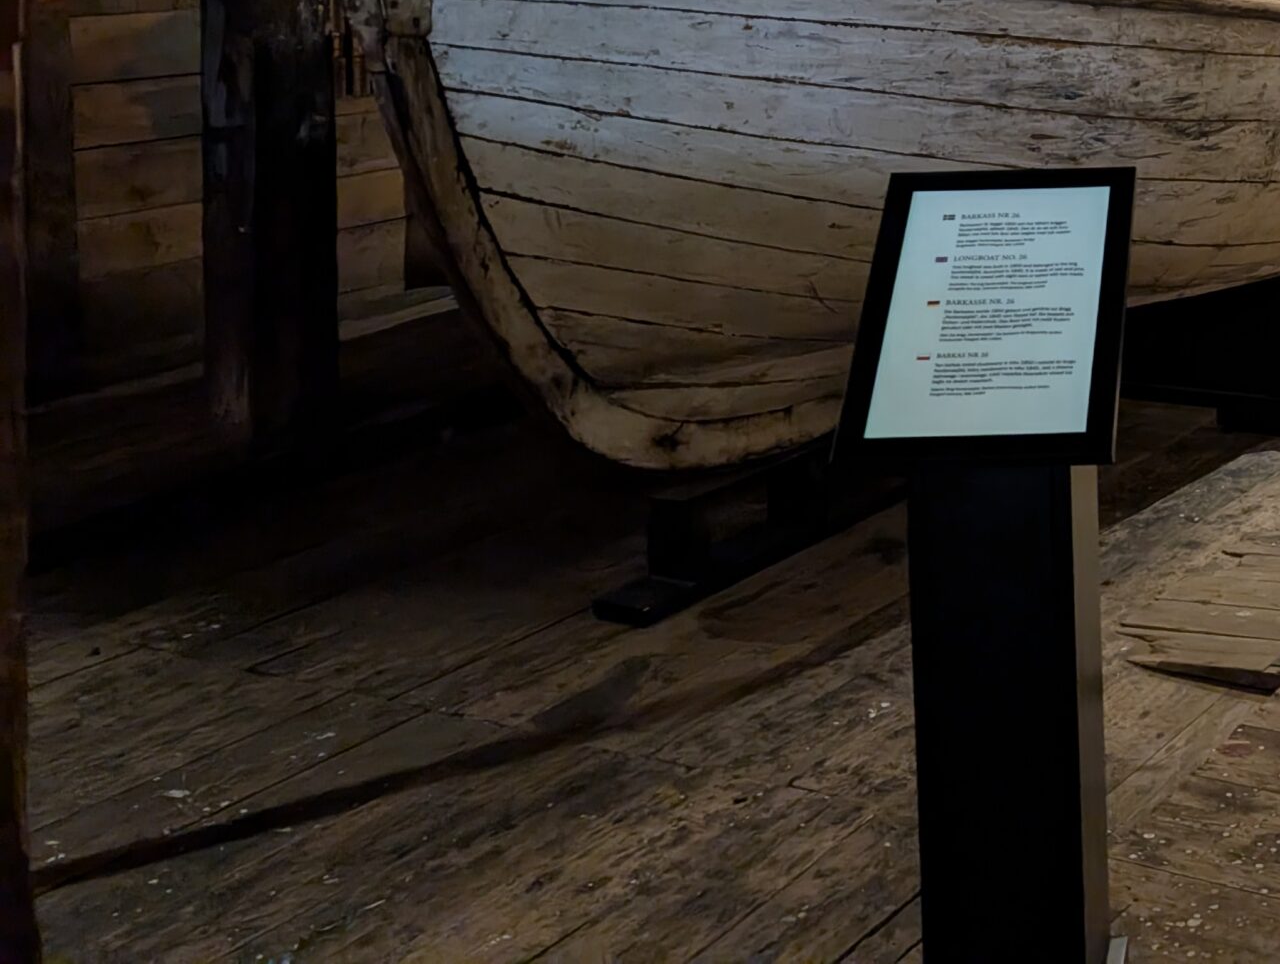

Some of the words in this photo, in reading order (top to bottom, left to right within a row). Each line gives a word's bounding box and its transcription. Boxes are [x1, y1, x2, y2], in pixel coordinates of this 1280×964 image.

[961, 212, 996, 220] BARKASS
[953, 254, 1000, 262] LONGBOAT
[945, 298, 987, 306] BARKASSE
[1006, 297, 1015, 305] 26
[936, 351, 966, 359] BARKAS
